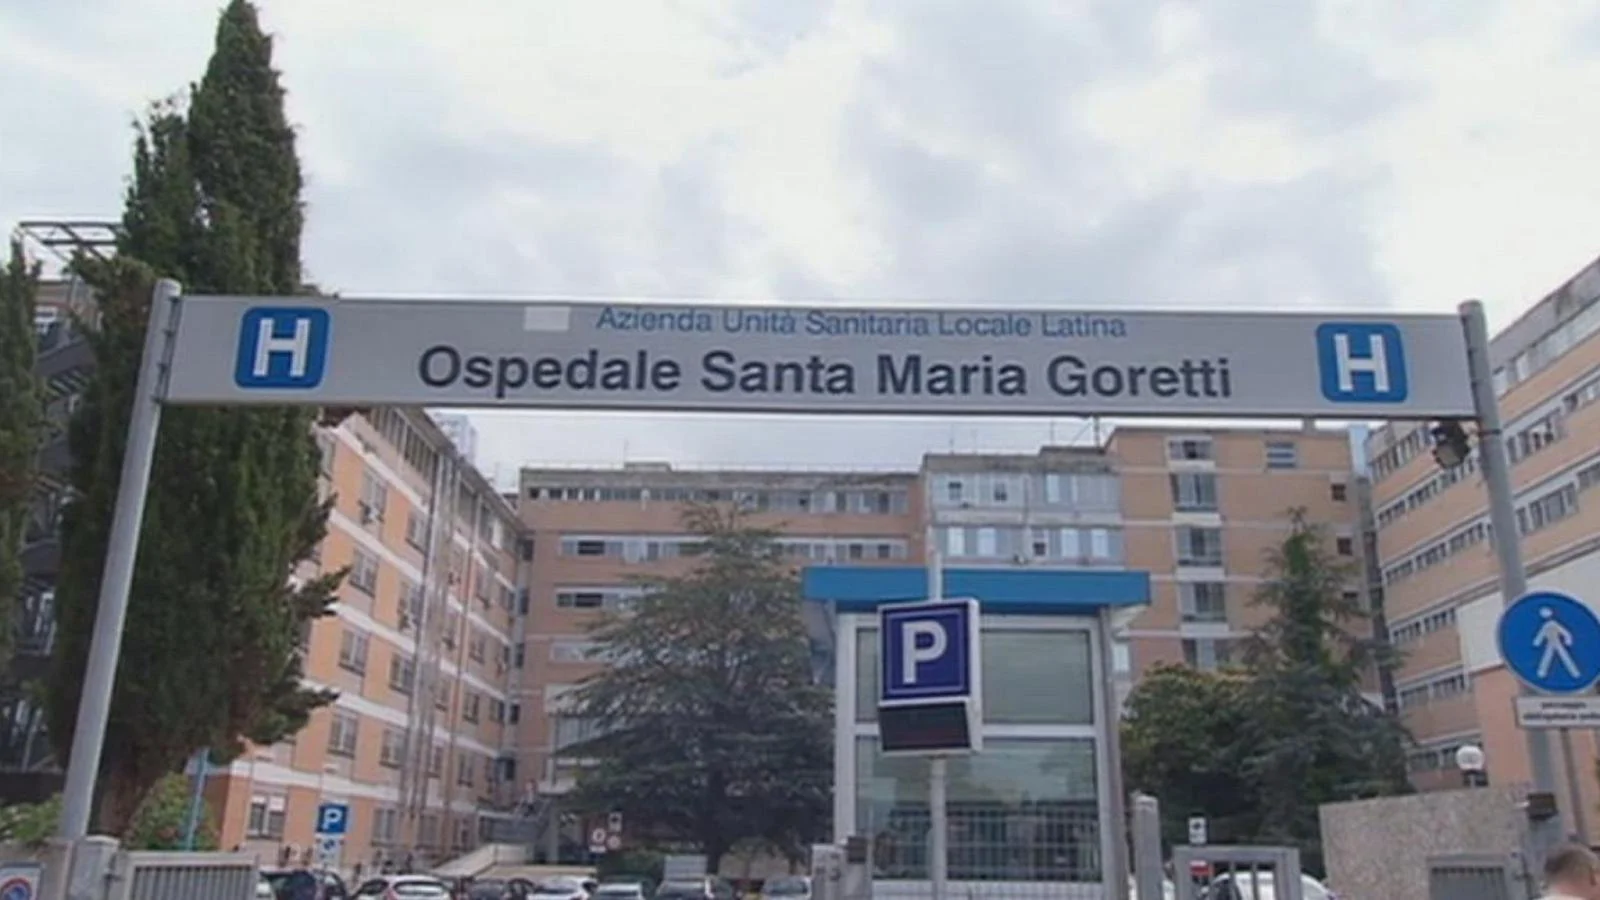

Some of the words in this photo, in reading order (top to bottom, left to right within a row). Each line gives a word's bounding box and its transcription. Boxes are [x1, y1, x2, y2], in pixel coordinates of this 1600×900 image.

[254, 318, 310, 377] H
[596, 306, 713, 332] Azienda
[722, 308, 797, 333] Unità
[804, 310, 930, 336] Sanitaria
[938, 313, 1032, 337] Locale
[1041, 314, 1129, 338] Latina
[417, 344, 682, 400] Ospedale
[700, 350, 856, 396] Santa
[877, 353, 1028, 398] Maria
[1047, 355, 1233, 399] Goretti
[1335, 333, 1390, 393] H
[902, 620, 947, 685] P
[323, 807, 343, 830] P
